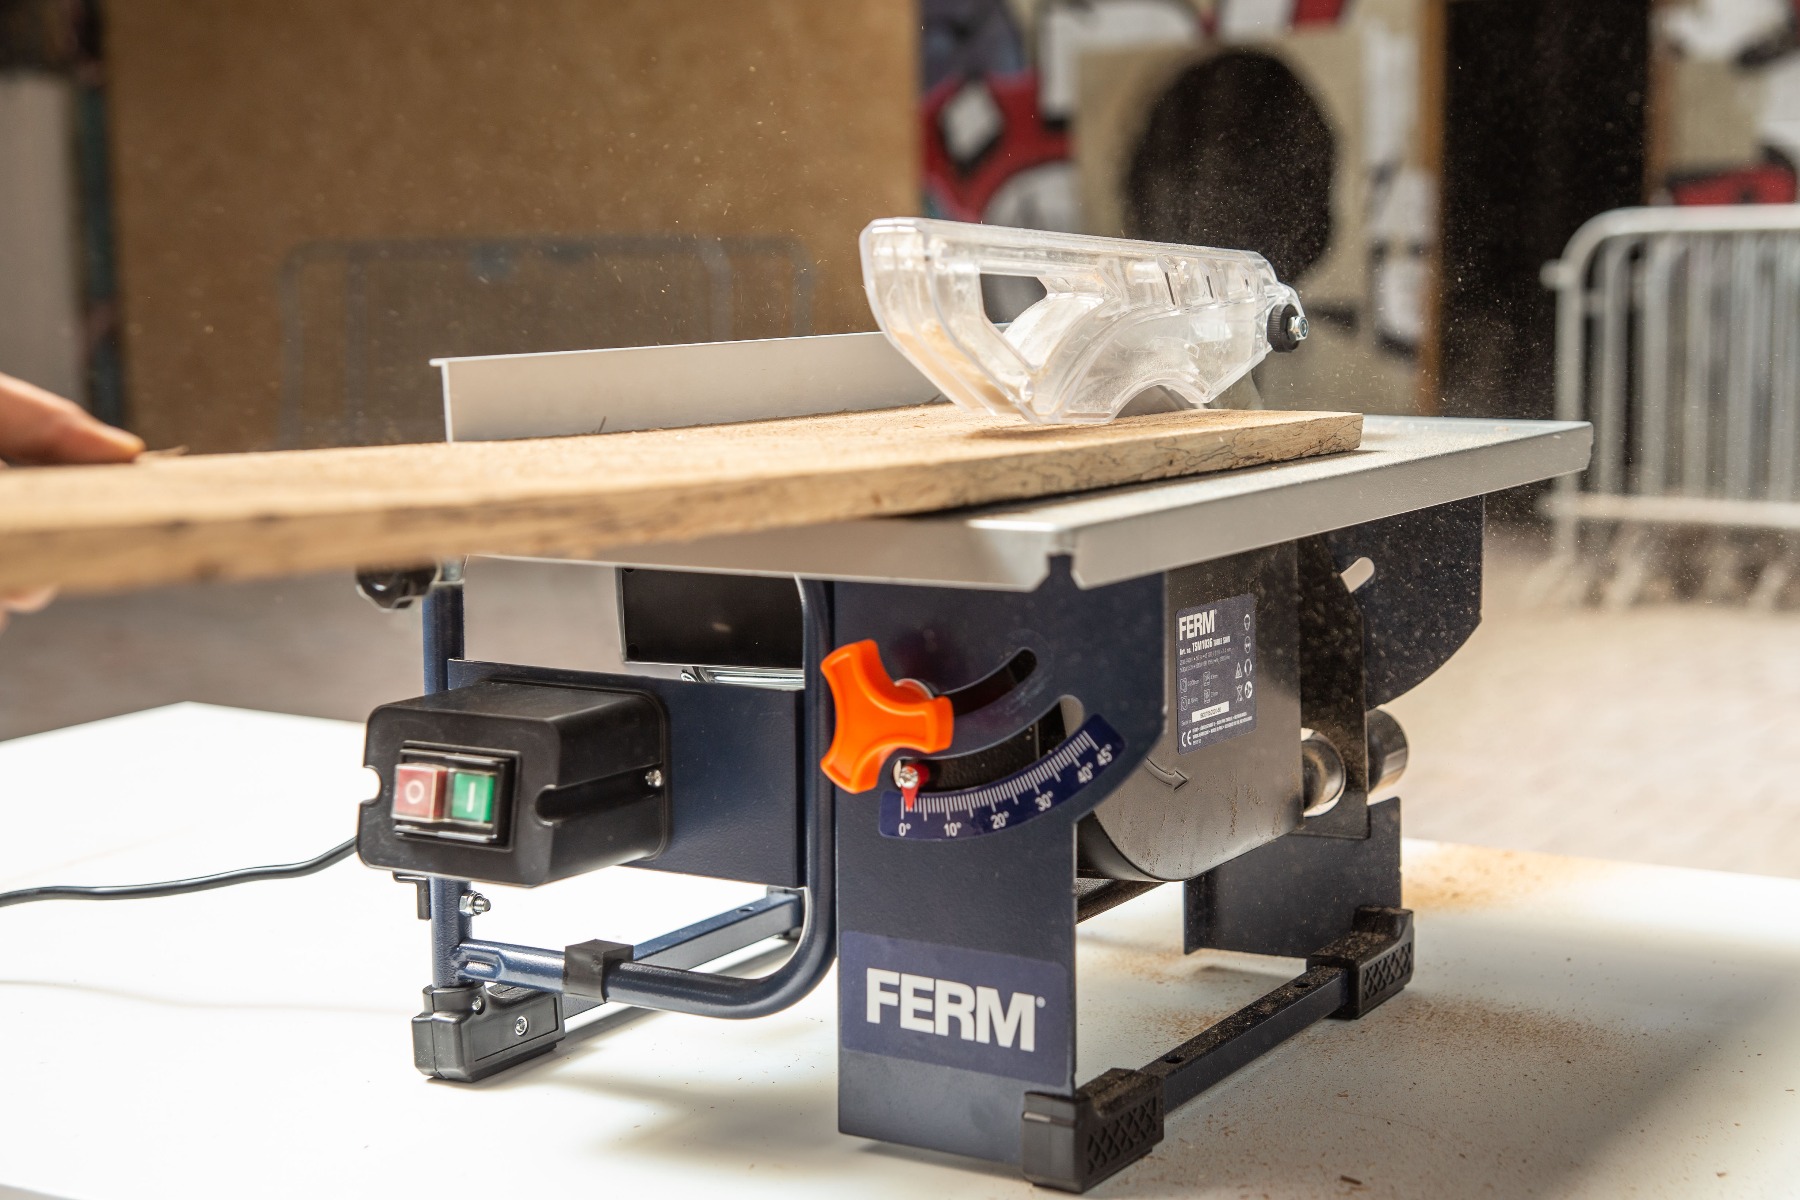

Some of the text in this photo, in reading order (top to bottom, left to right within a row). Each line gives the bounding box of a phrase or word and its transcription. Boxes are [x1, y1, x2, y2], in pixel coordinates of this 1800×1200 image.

[1179, 610, 1215, 641] FERM
[1097, 744, 1113, 766] 45°
[1077, 762, 1093, 784] 40°
[1035, 791, 1054, 812] 30°
[944, 822, 962, 837] 10°
[991, 811, 1009, 829] 20°
[867, 967, 1036, 1052] FERM
